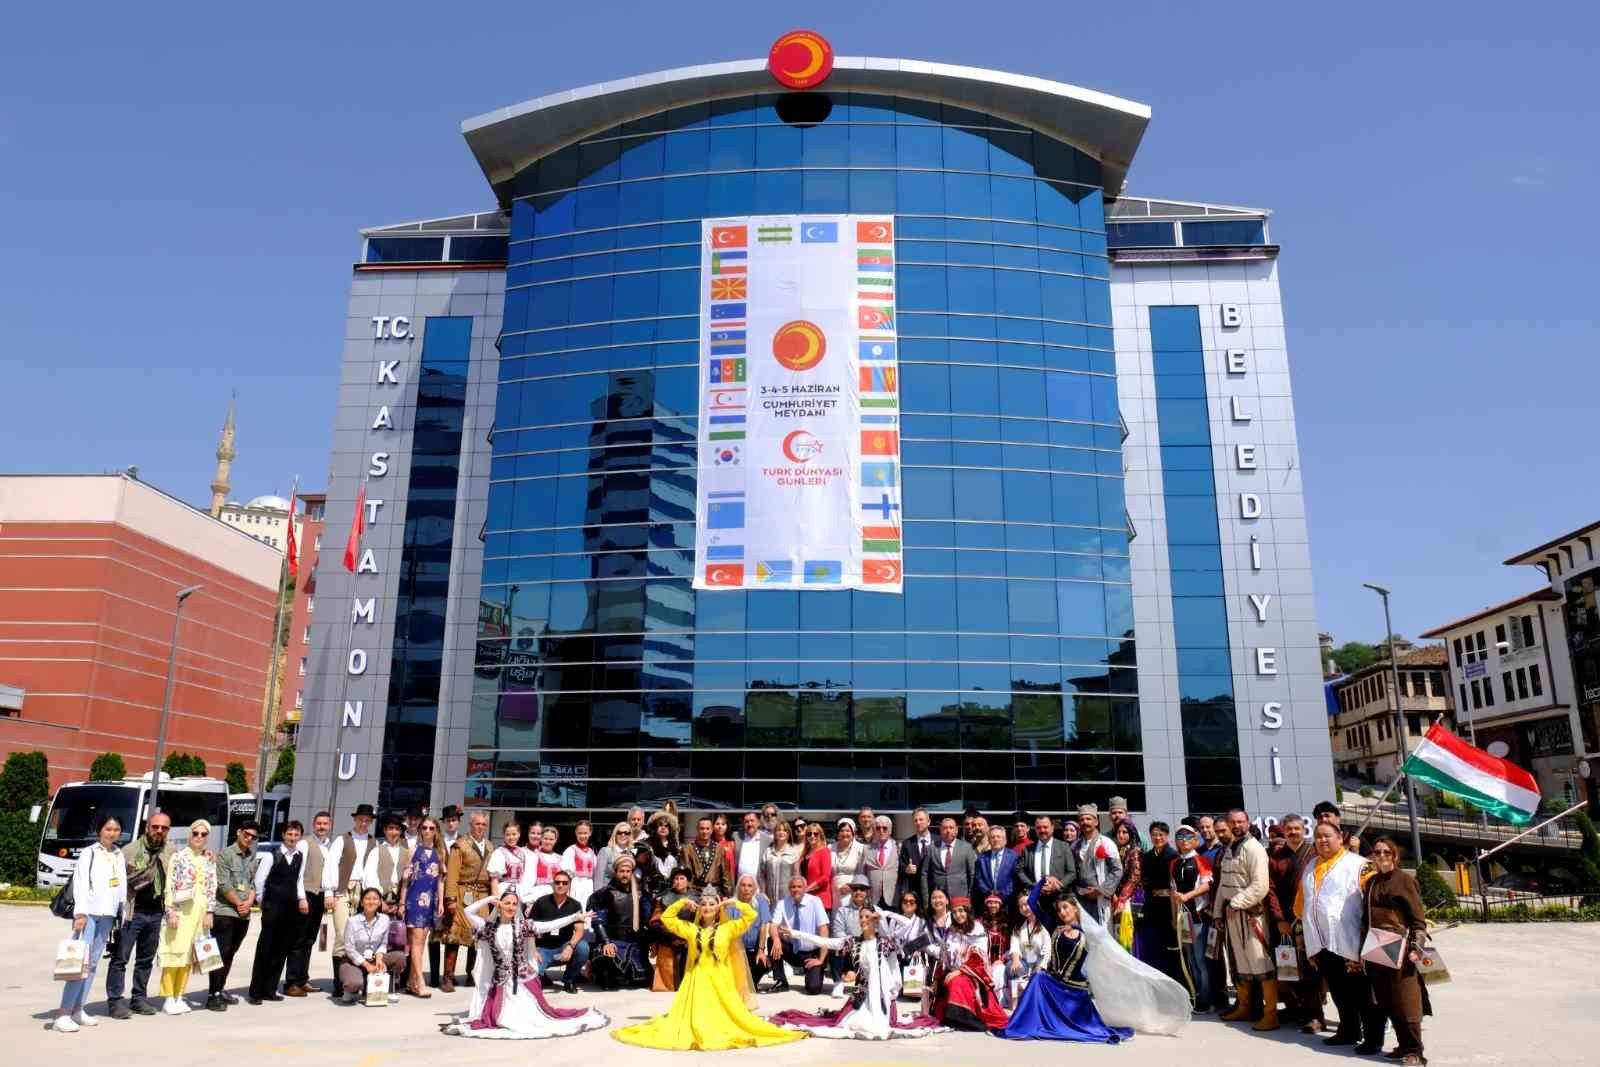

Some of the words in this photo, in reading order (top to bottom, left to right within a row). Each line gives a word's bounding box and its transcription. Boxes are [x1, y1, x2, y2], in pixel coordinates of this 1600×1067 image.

[372, 316, 414, 339] T.C.
[791, 383, 840, 393] HAZİRAN
[762, 399, 837, 409] CUMHURİYET
[774, 409, 826, 417] MEYDANI
[337, 360, 400, 780] KASTAMONU
[1252, 815, 1313, 839] 183
